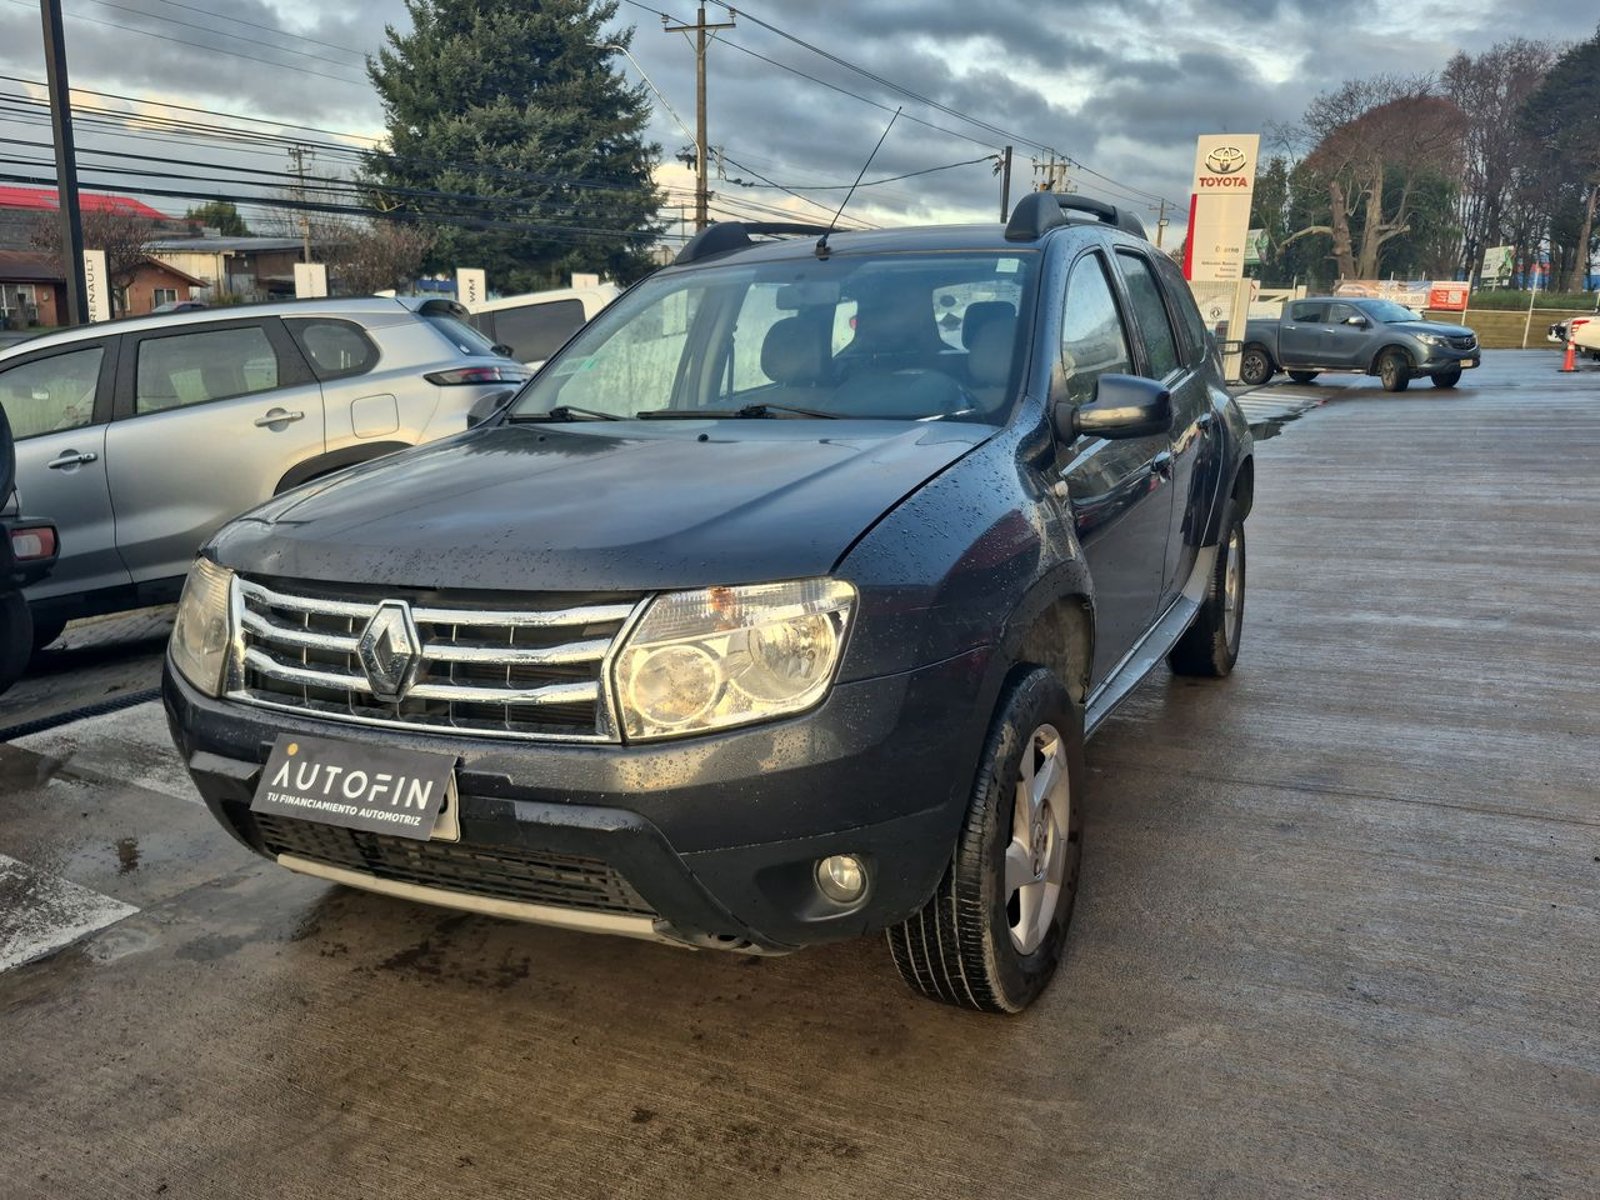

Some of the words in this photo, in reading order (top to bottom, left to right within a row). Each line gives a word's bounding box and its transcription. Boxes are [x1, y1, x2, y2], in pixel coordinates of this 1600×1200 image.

[1199, 177, 1248, 187] TOYOTA
[86, 256, 97, 322] RENAULT
[271, 760, 433, 810] AUTOFIN
[267, 792, 280, 802] TU
[280, 794, 357, 815] FINANCIAMIENTO
[359, 808, 421, 826] AUTOMOTRIZ
